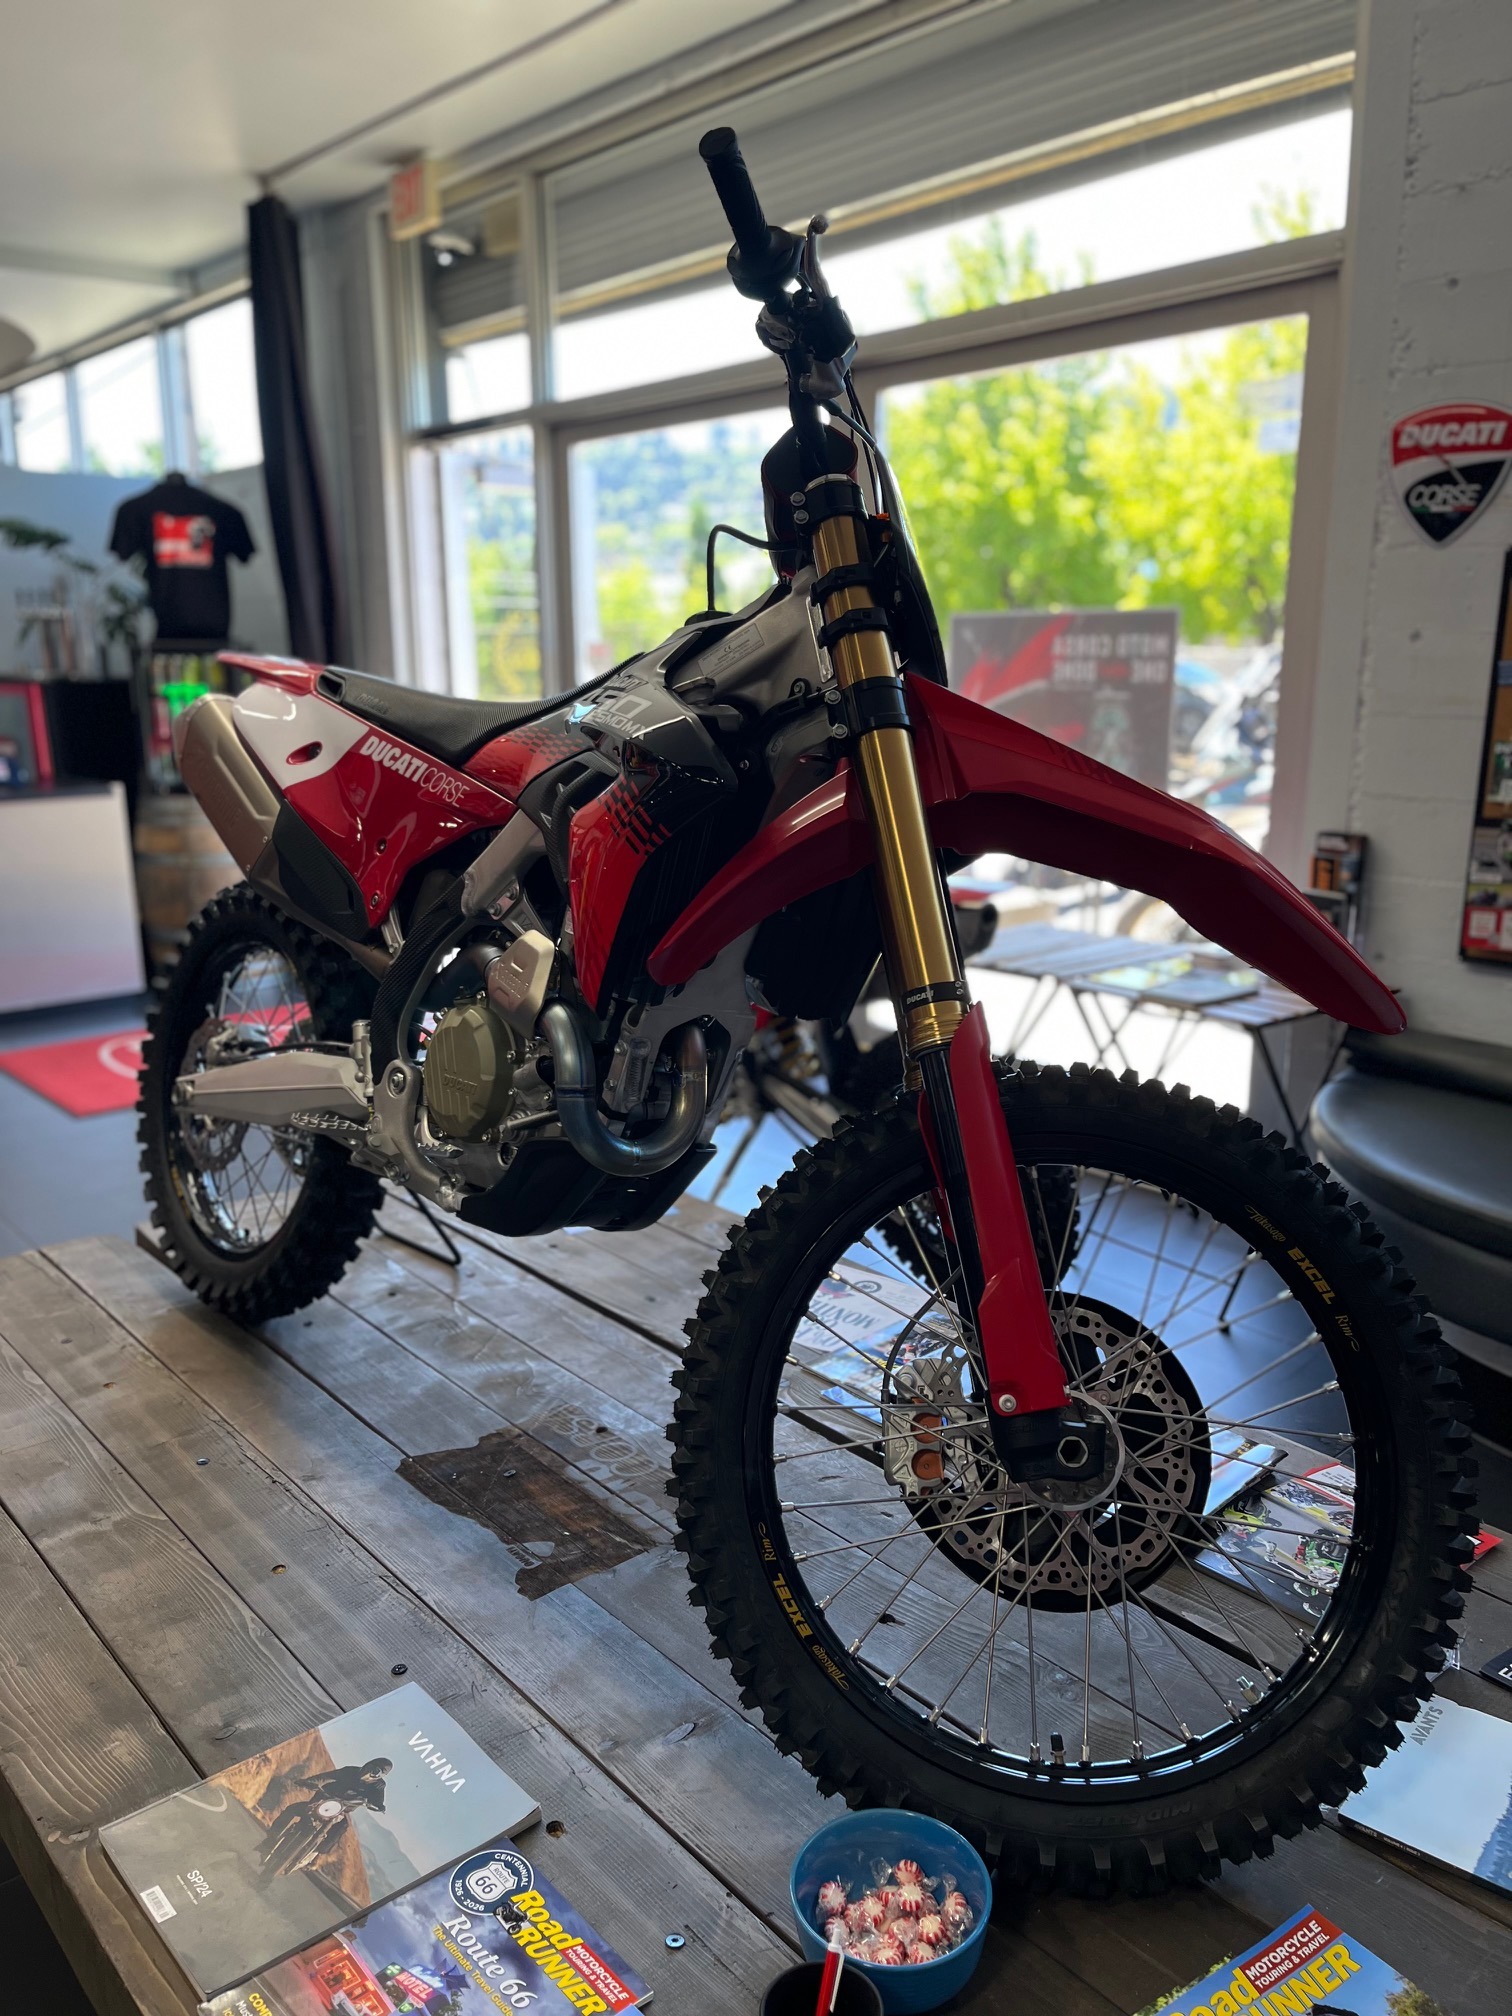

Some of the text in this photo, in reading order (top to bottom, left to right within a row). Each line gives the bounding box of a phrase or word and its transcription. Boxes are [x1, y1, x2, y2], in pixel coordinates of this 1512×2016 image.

[1398, 420, 1508, 449] DUCATI
[1408, 483, 1482, 509] CORSE
[360, 736, 470, 808] DUCATI CORSE
[906, 990, 934, 1005] DUCATI
[1244, 1204, 1360, 1352] Takasago EXCEL Rim
[758, 1521, 850, 1691] Takasago EXCEL Rim
[1410, 1705, 1444, 1746] AVANTS
[186, 1869, 213, 1898] SP/24
[454, 1879, 464, 1896] 1926
[463, 1899, 485, 1912] 2026
[475, 1875, 498, 1894] 66
[493, 1867, 509, 1884] ROUTE
[494, 1853, 530, 1888] CENTENNIAL
[510, 1889, 584, 1950] Road
[432, 1924, 514, 2016] The Ultimate Travel Guide
[441, 1913, 538, 2008] Route 66
[511, 1926, 608, 2016] RUNNER
[565, 1948, 592, 1976] TOURING
[594, 1980, 618, 2004] TRAVEL
[572, 1944, 630, 2000] MOTORCYCLE
[1245, 1919, 1322, 1981] MOTORCYCLE
[1255, 1932, 1331, 1990] TOURING & TRAVEL
